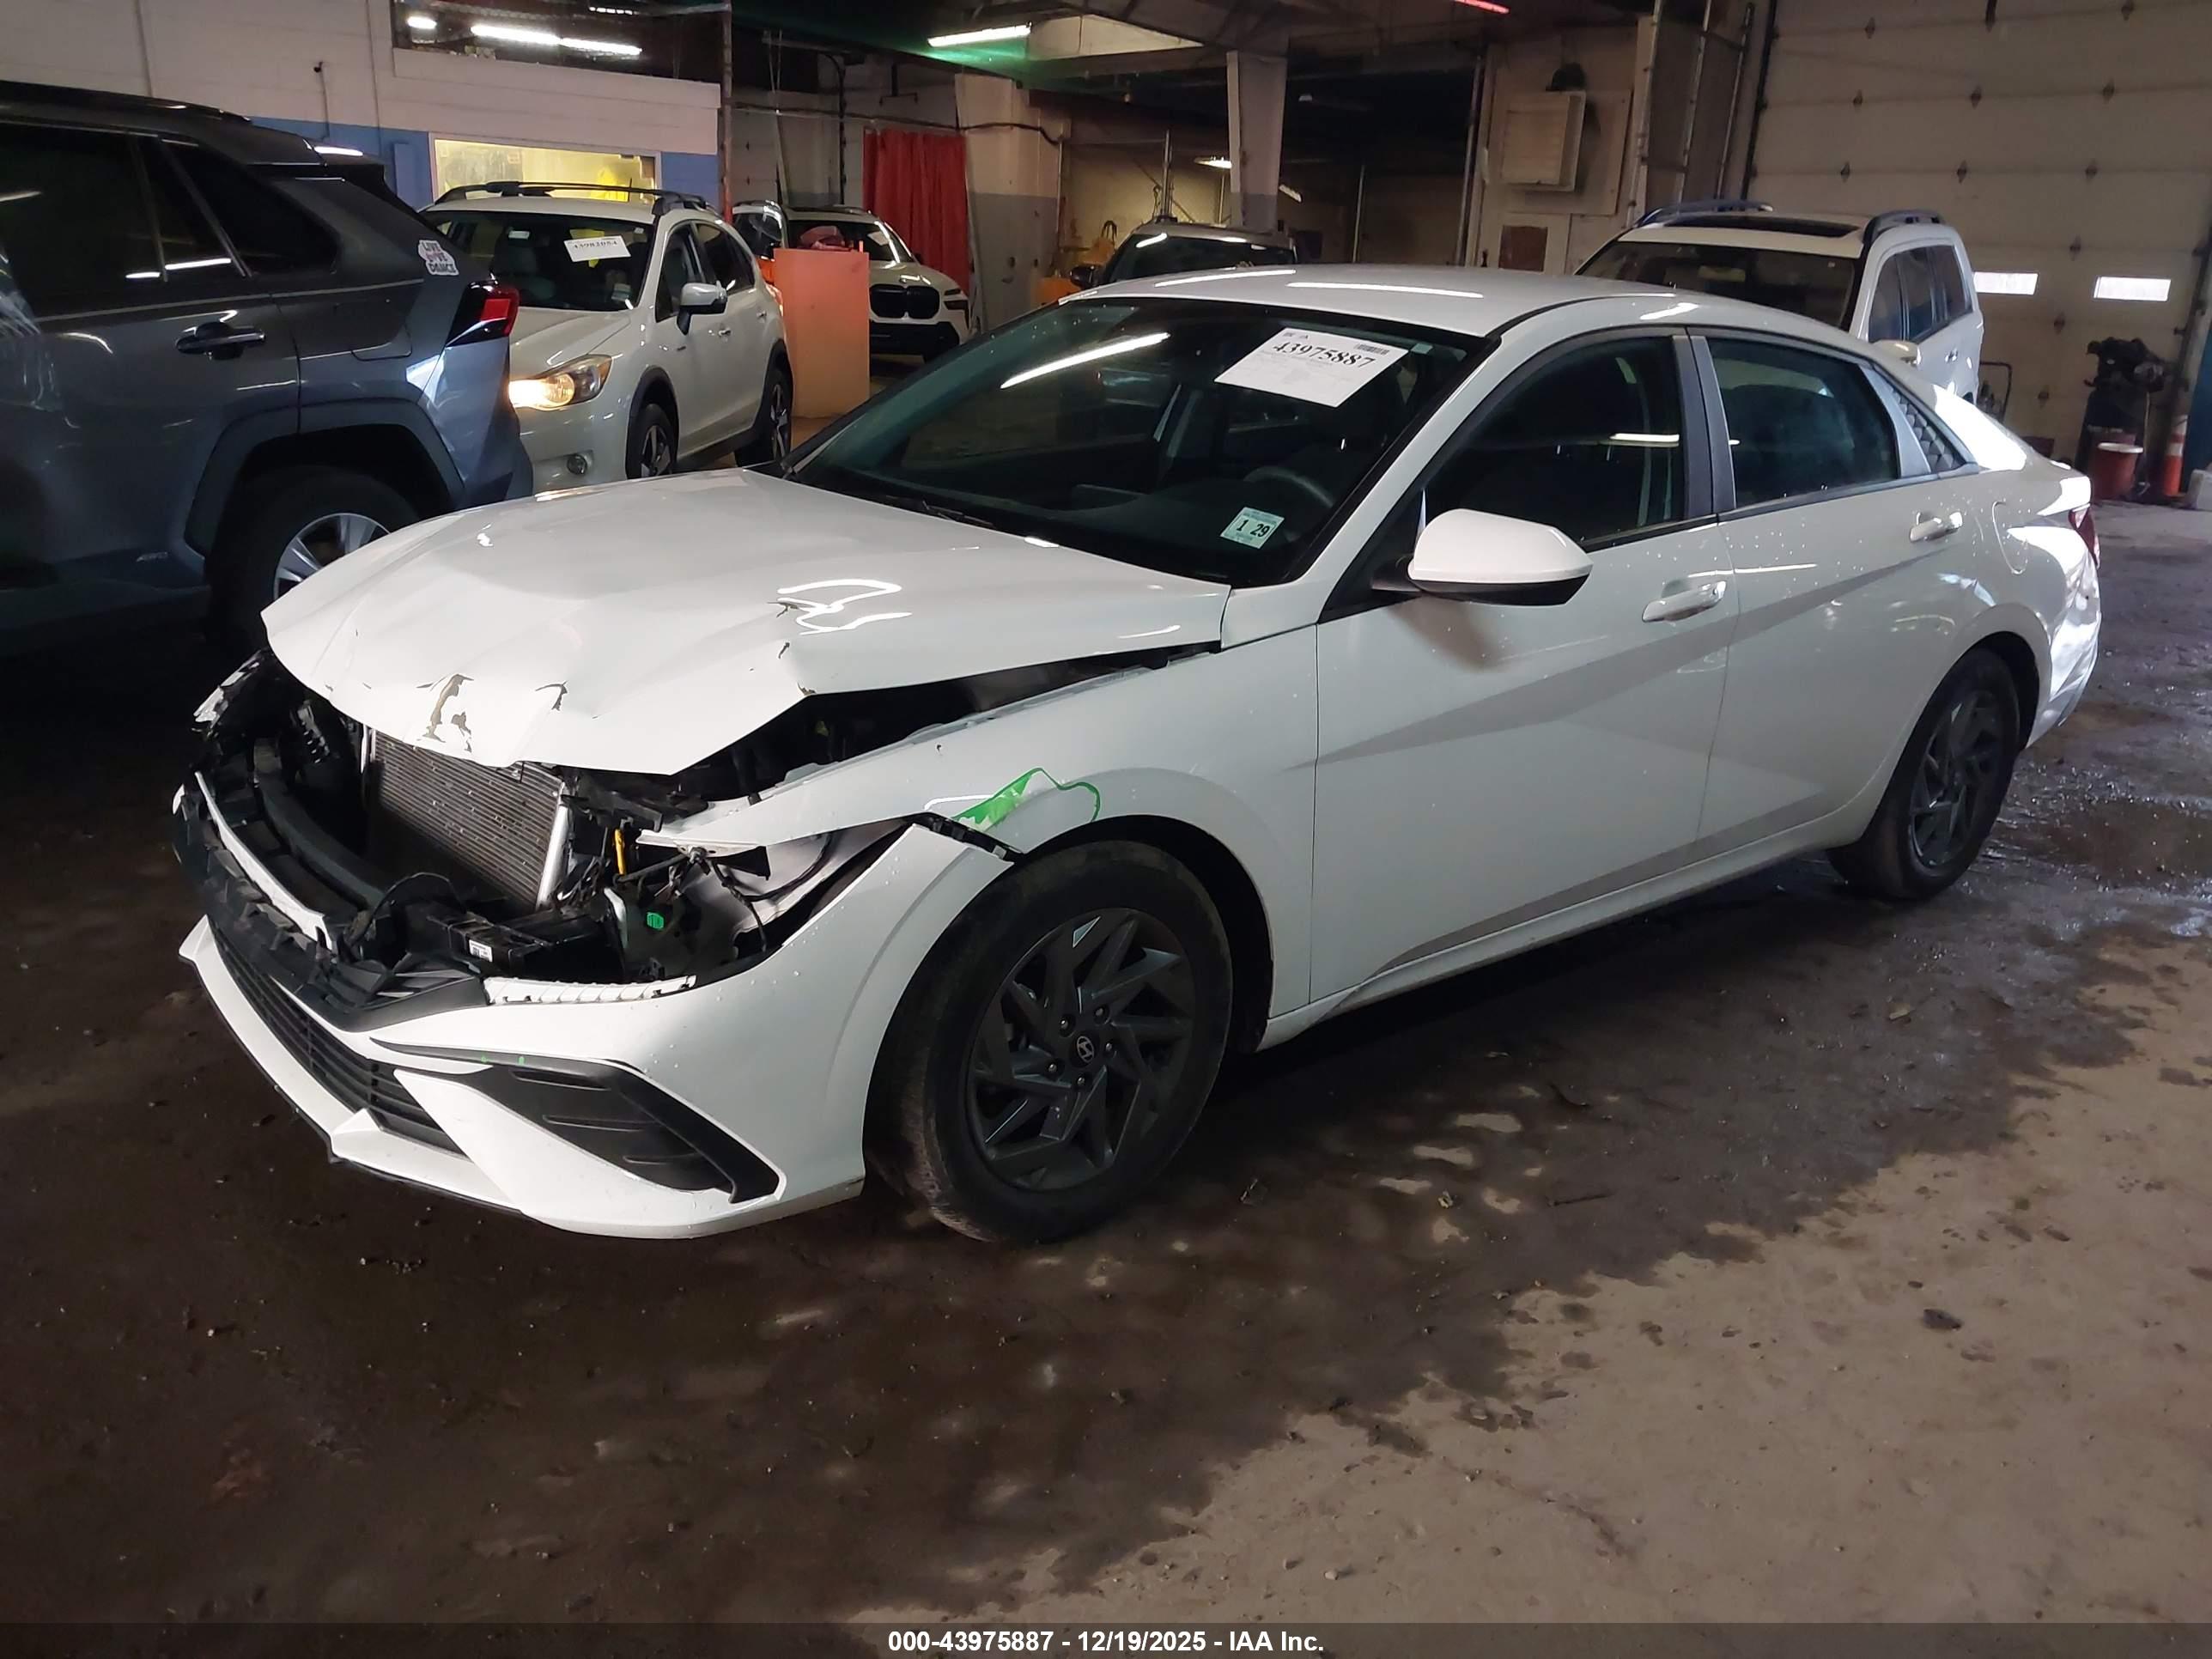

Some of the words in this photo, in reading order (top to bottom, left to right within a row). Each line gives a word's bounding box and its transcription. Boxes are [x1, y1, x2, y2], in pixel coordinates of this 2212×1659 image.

[1273, 342, 1376, 369] 43975887
[1237, 520, 1249, 532] 1
[1250, 524, 1270, 537] 29
